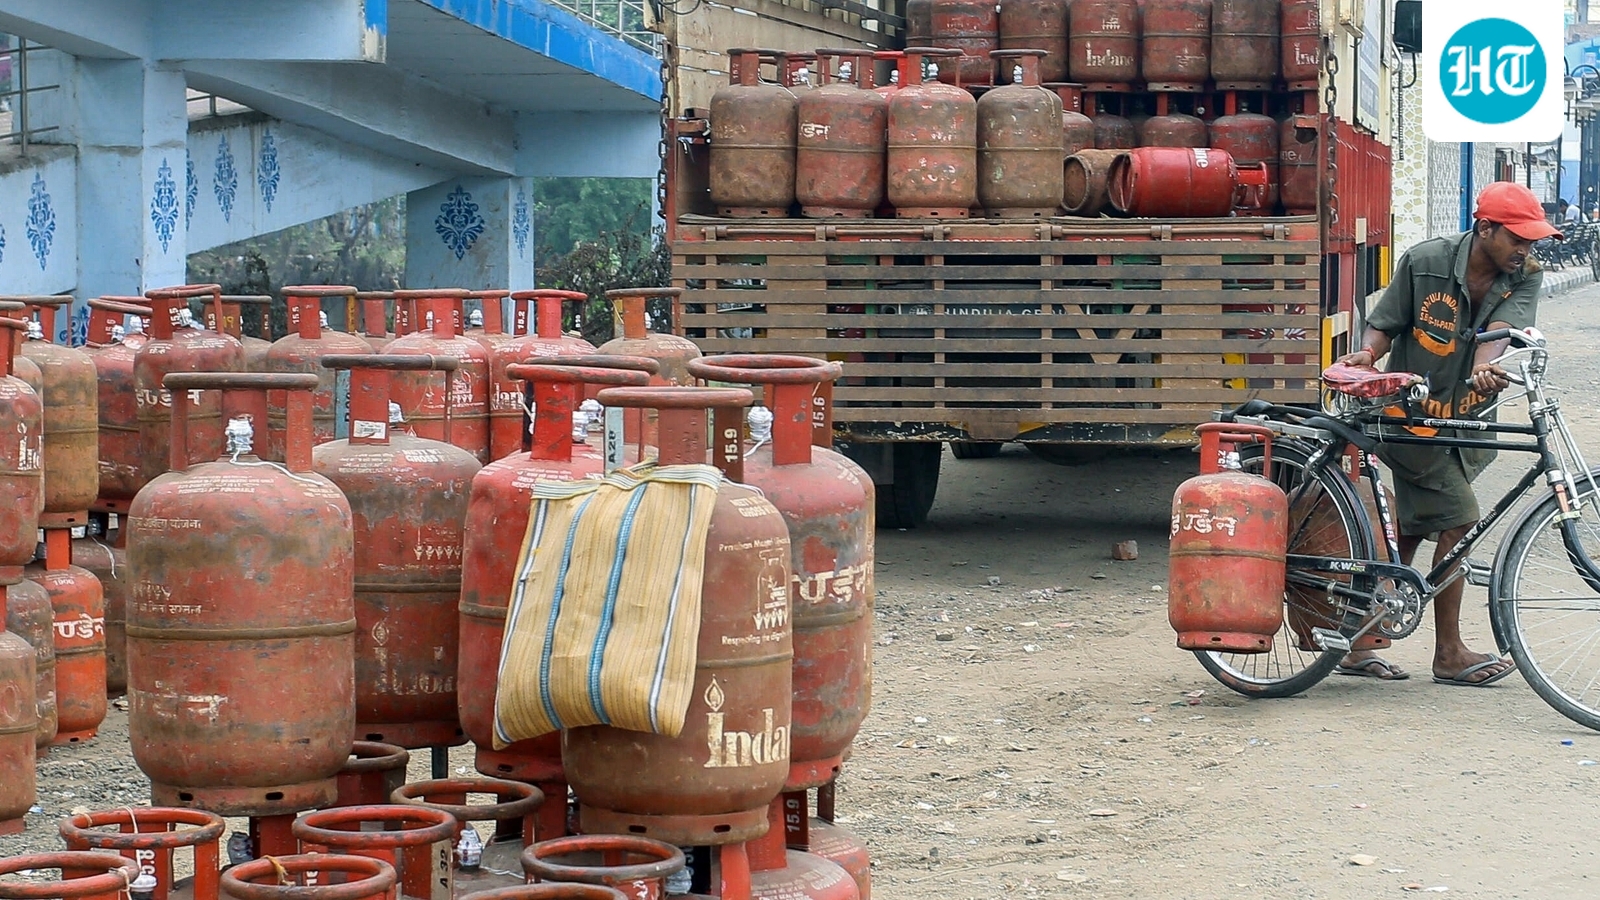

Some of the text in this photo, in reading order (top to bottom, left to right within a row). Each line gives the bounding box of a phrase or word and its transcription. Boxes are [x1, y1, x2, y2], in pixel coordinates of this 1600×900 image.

[1086, 47, 1134, 67] Indane
[169, 307, 180, 326] 15.5
[812, 396, 825, 429] 15.6
[724, 428, 738, 463] 15.9
[787, 799, 800, 832] 15.9
